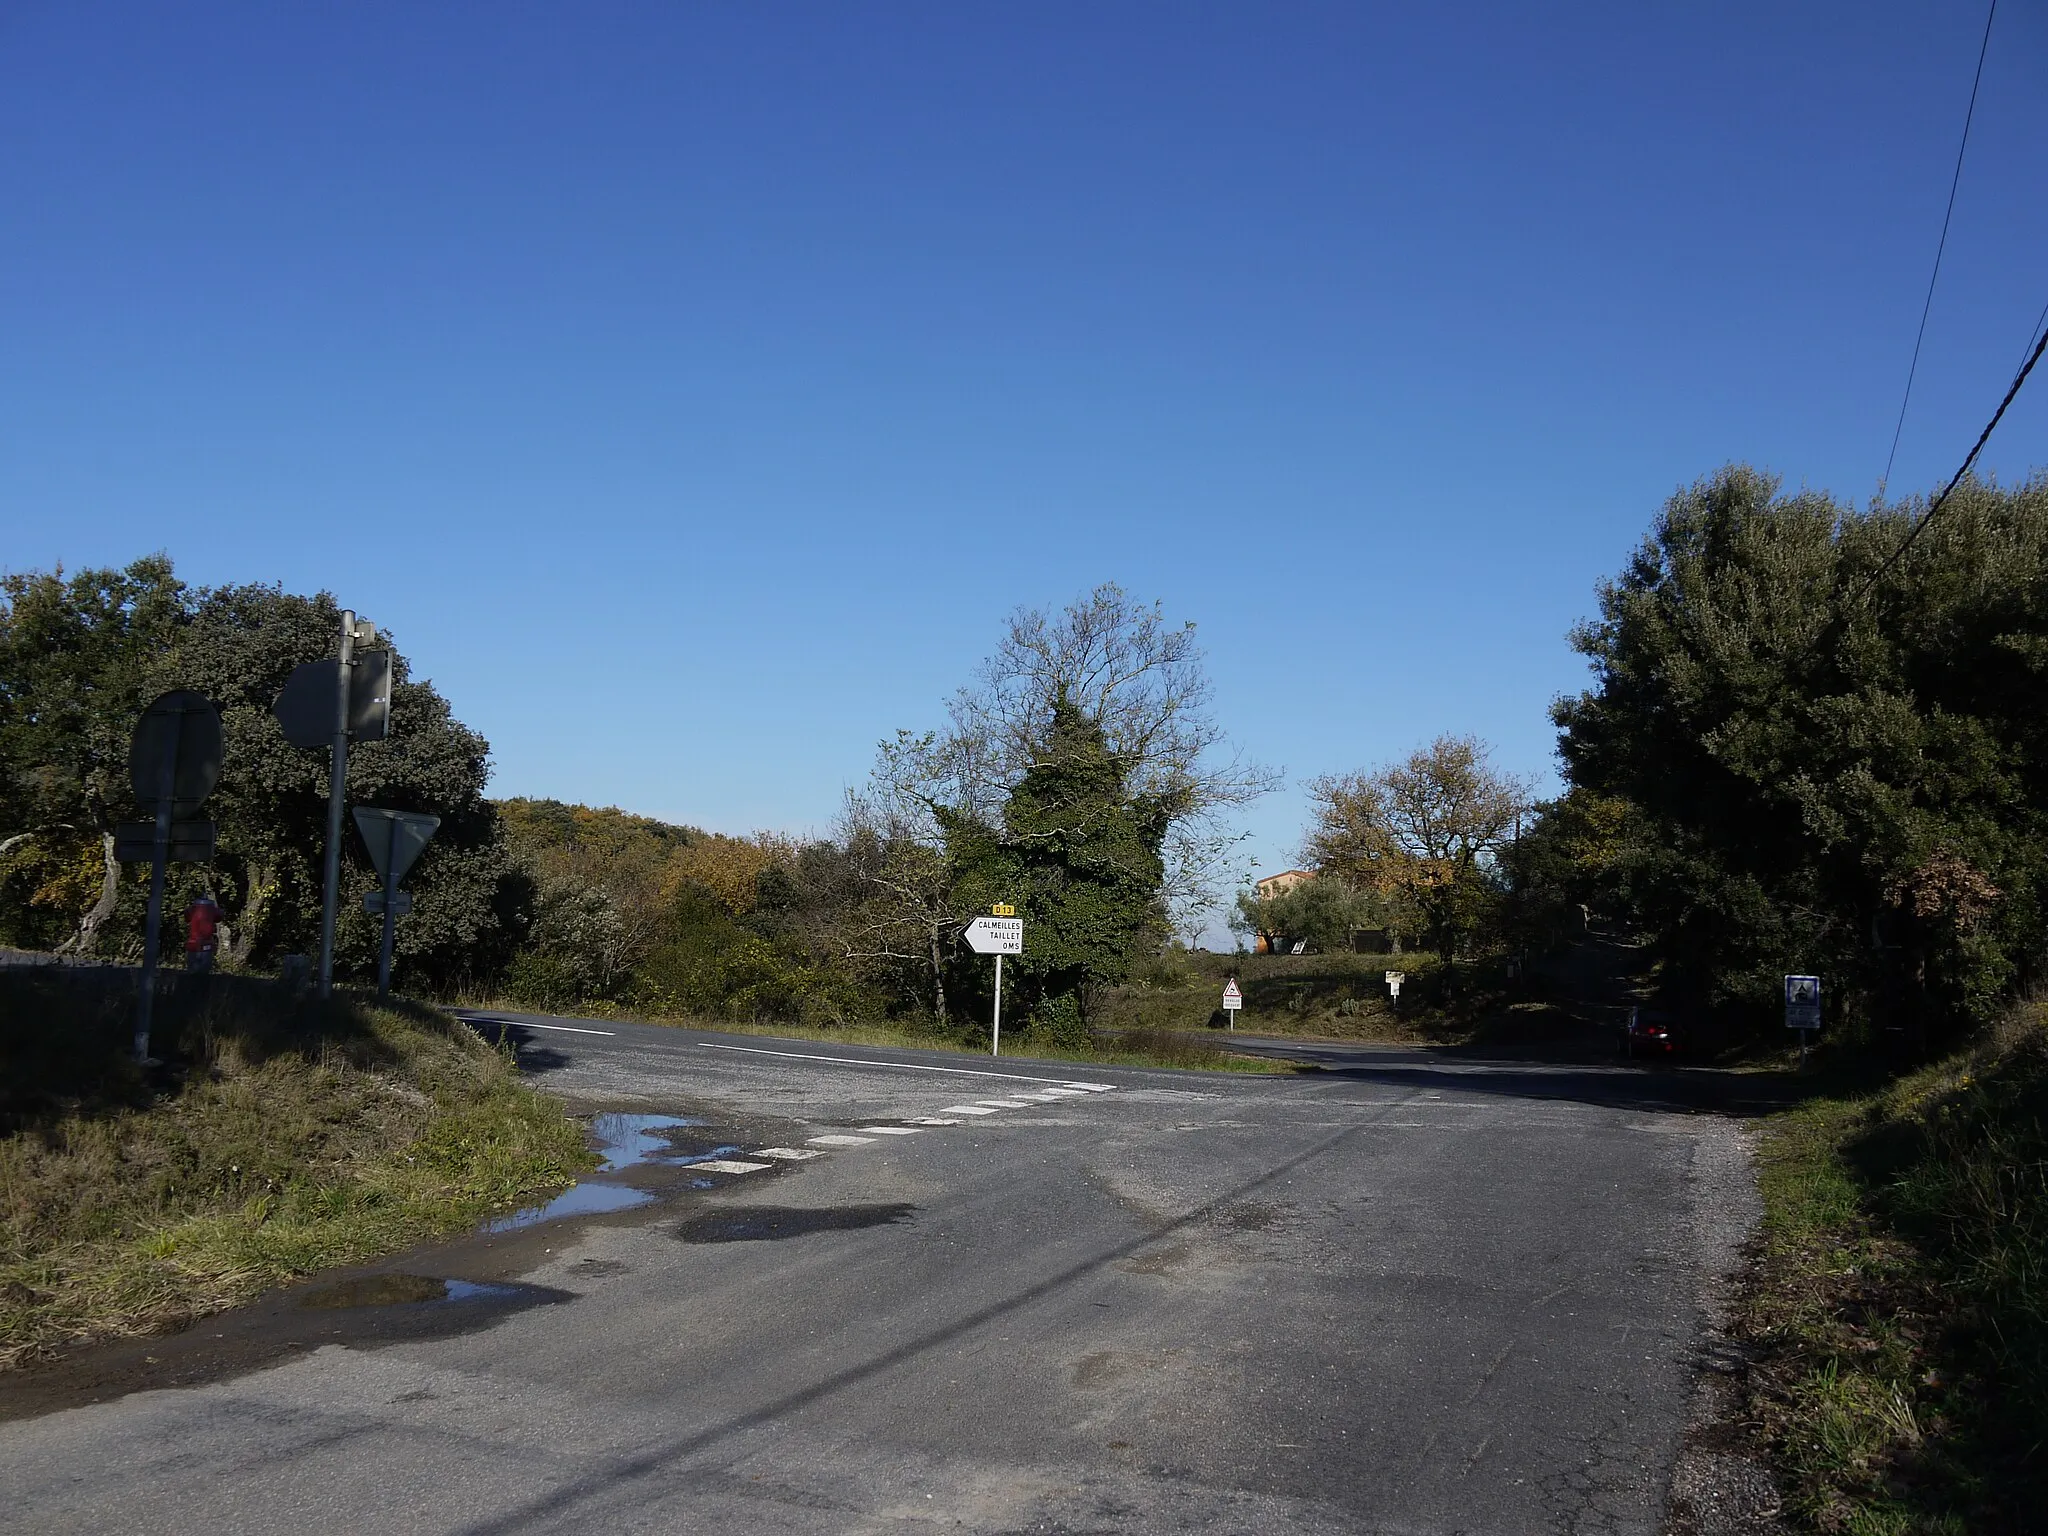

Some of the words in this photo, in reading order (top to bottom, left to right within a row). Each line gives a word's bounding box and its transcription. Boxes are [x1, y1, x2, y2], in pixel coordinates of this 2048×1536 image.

[978, 921, 1020, 930] CALMEILLES
[990, 931, 1020, 940] TAILLET
[1002, 942, 1020, 950] OMS
